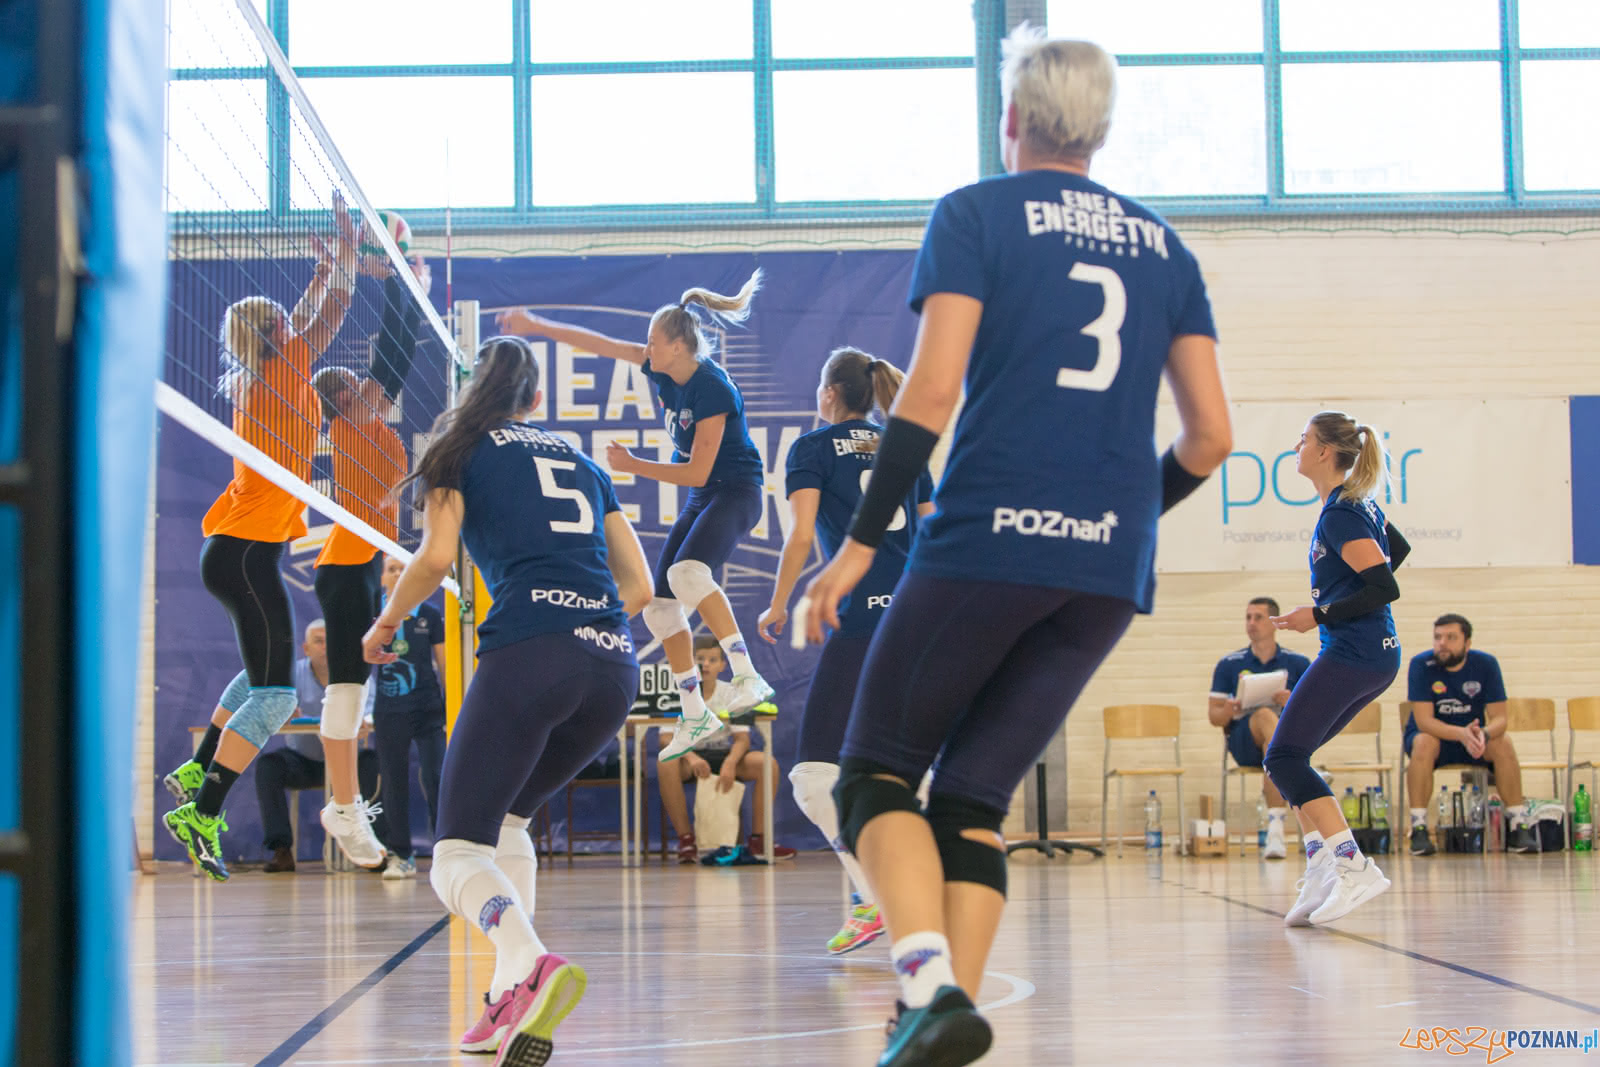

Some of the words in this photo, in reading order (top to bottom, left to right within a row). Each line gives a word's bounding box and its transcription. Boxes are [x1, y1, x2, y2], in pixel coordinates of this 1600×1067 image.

[1060, 188, 1126, 217] ENEA
[1055, 260, 1128, 393] 3
[532, 455, 595, 535] 5
[1220, 431, 1424, 525] poir
